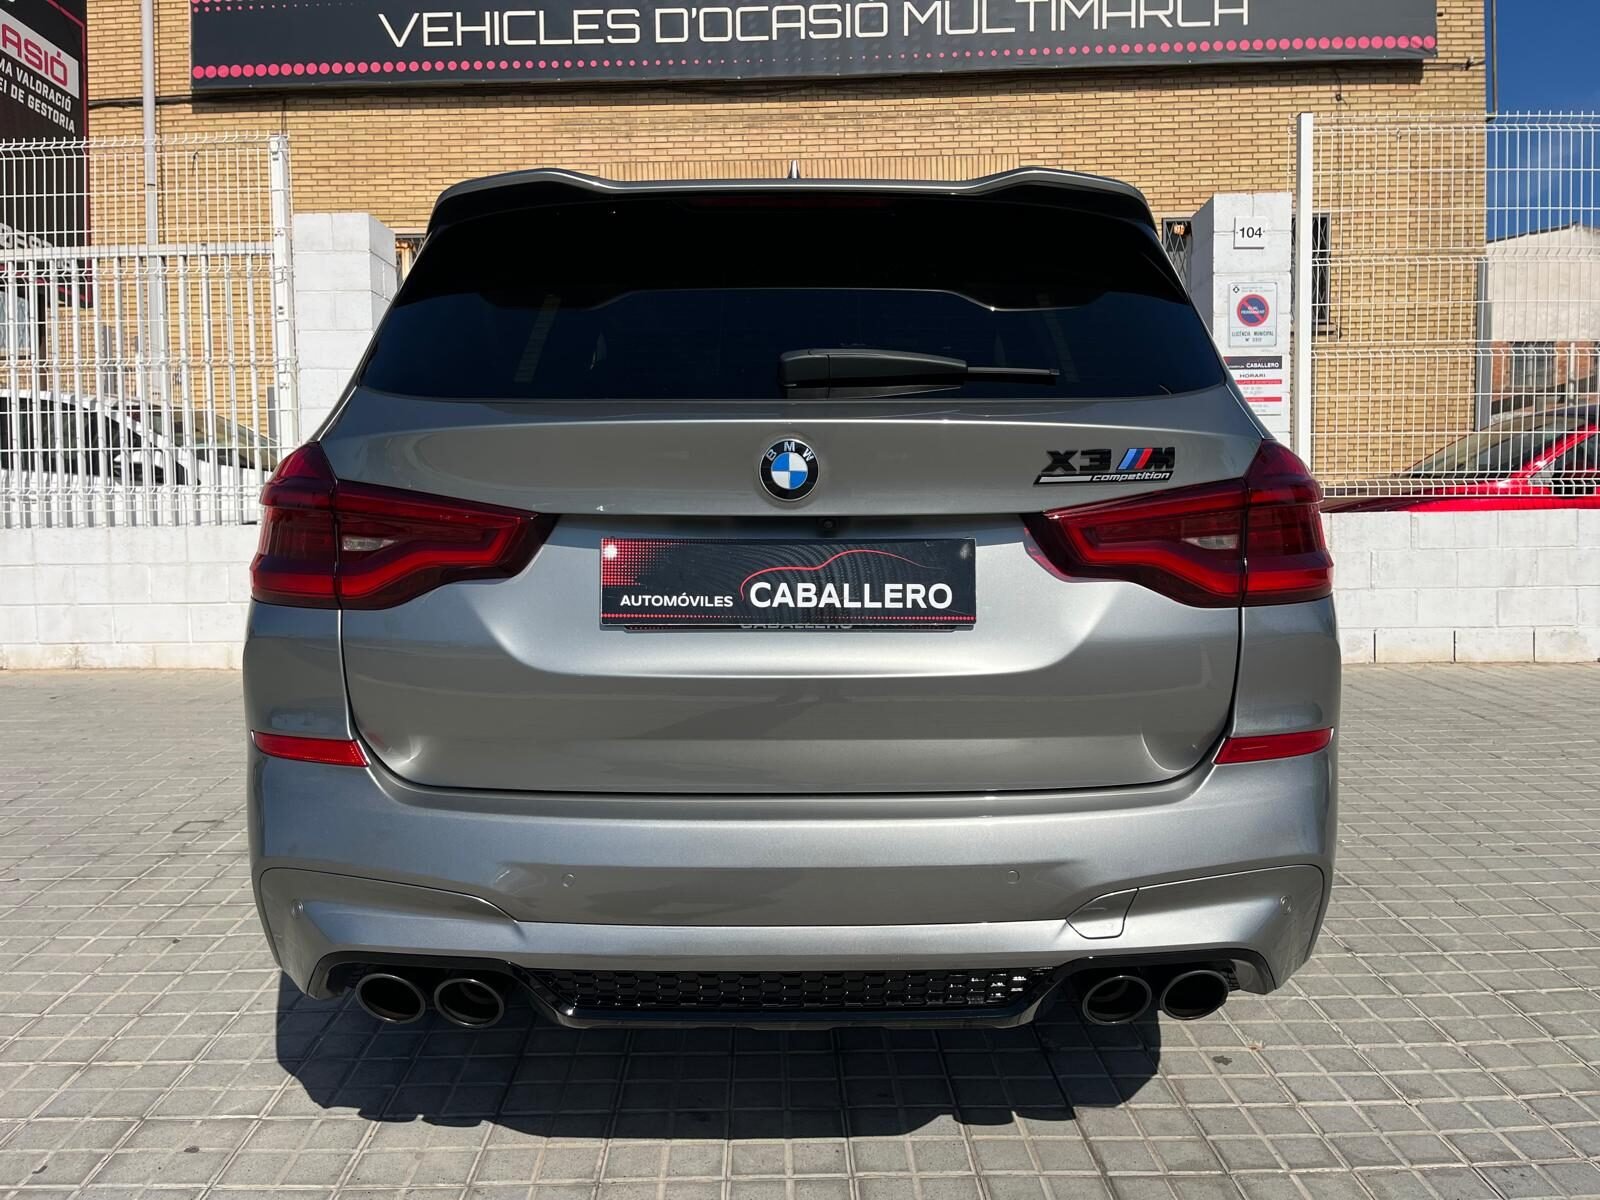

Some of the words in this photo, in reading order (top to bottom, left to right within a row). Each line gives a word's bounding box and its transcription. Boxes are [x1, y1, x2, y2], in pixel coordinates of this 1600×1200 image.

[378, 8, 640, 48] VEHICLES
[903, 0, 1249, 37] MULTIMARCA
[16, 66, 72, 113] VALORACIÓ
[11, 84, 25, 104] DE
[27, 94, 76, 134] GESTORIA
[1239, 226, 1263, 239] 104
[766, 441, 815, 462] BMW
[1041, 449, 1112, 473] X3
[1092, 471, 1171, 483] competition
[620, 592, 734, 608] AUTOMÓVILES
[750, 582, 953, 610] CABALLERO
